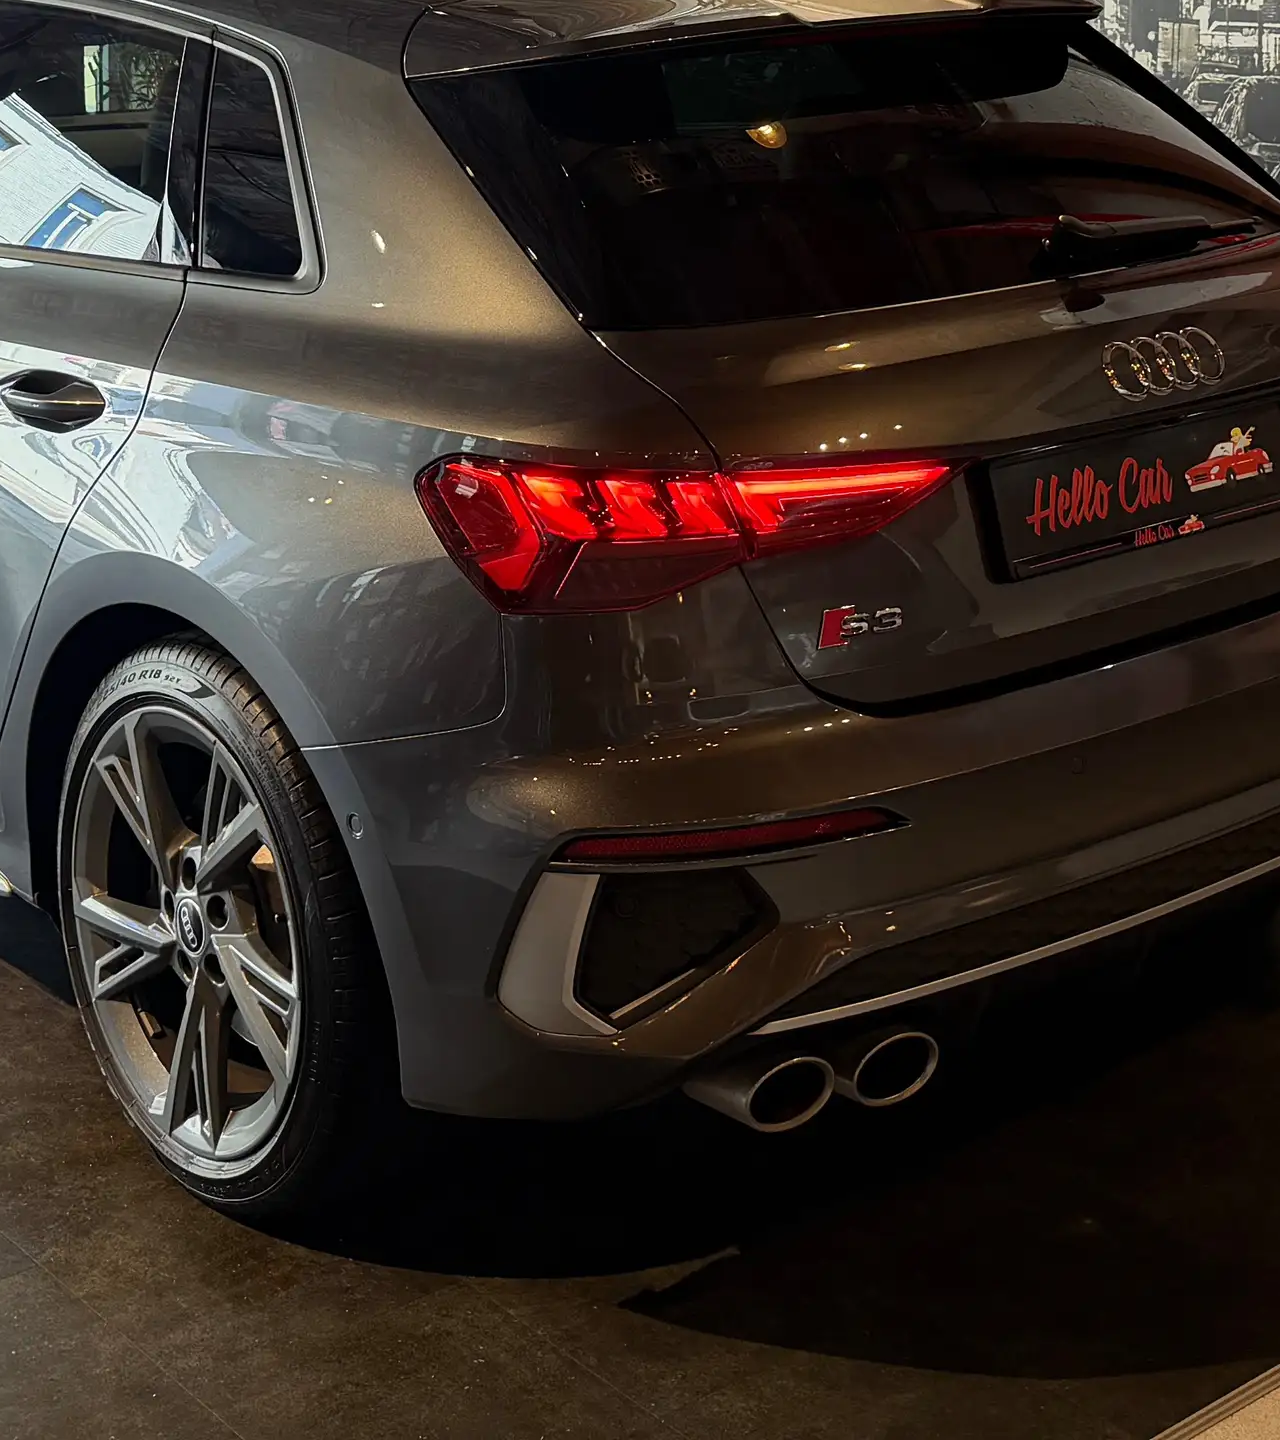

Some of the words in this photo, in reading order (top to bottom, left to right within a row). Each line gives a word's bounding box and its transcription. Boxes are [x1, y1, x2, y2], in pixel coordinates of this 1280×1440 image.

[1025, 465, 1113, 536] Hello
[1118, 457, 1173, 514] Car
[1134, 526, 1157, 547] Hello
[1157, 524, 1175, 541] Car
[840, 607, 902, 638] S3
[138, 669, 162, 681] R18
